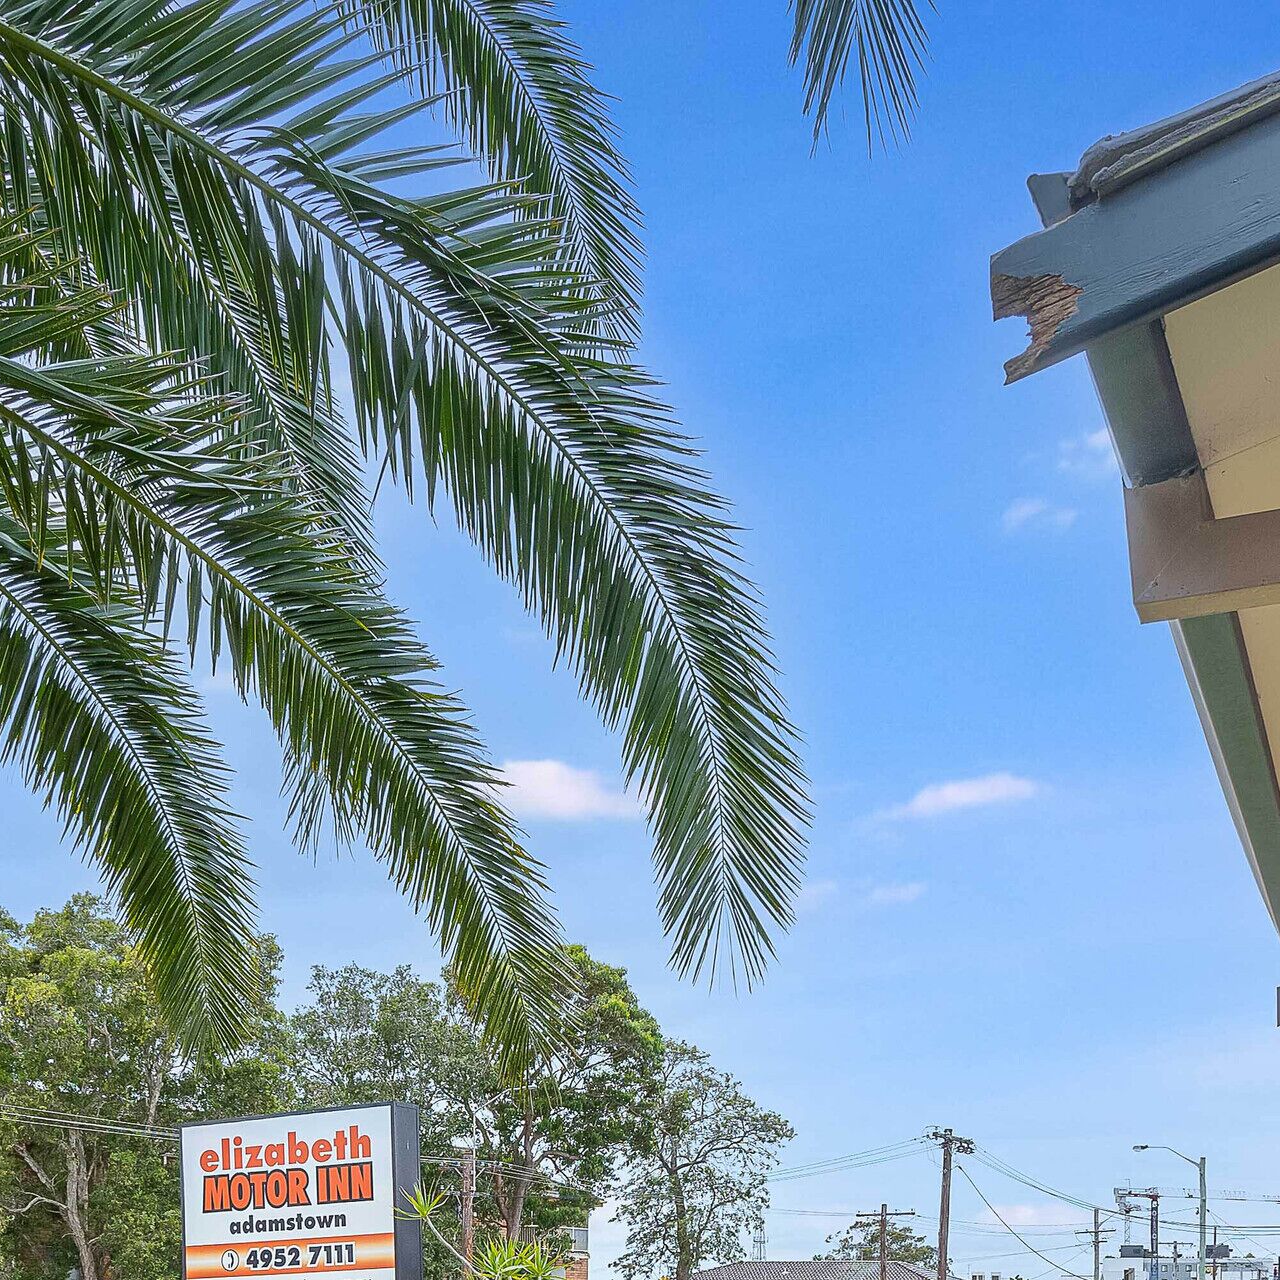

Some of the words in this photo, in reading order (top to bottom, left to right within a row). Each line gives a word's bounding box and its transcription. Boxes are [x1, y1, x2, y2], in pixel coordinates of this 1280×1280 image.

[200, 1125, 371, 1172] elizabeth
[203, 1168, 312, 1213] MOTOR
[316, 1161, 374, 1205] INN
[230, 1213, 347, 1234] adamstown
[247, 1247, 300, 1268] 4952
[309, 1244, 354, 1265] 7111
